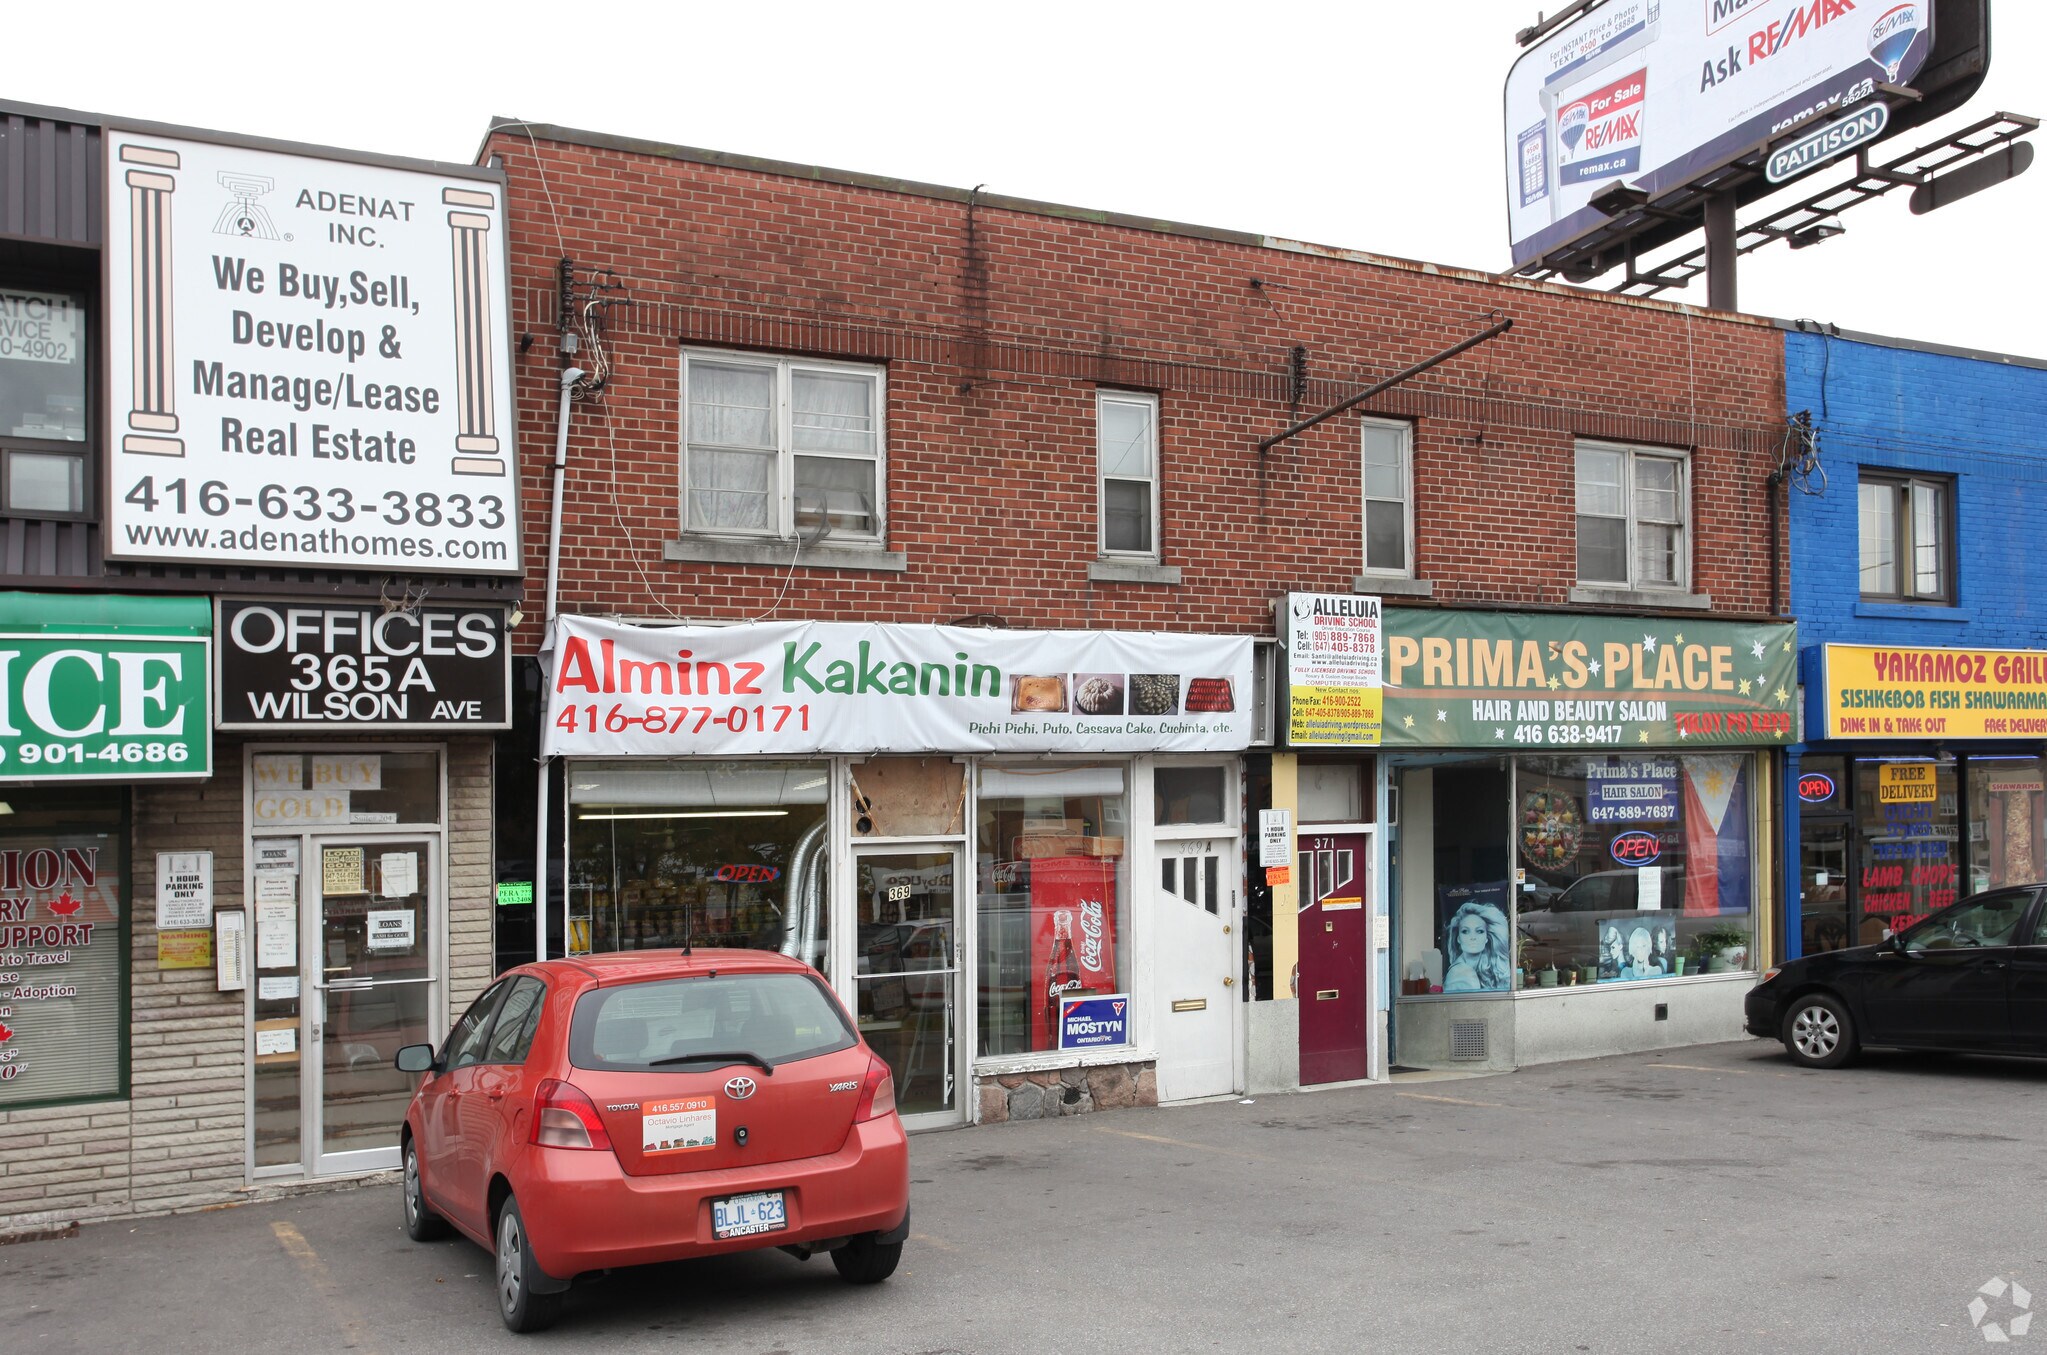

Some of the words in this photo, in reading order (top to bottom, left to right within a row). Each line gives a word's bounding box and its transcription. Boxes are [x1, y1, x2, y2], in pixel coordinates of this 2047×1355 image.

[1550, 52, 1560, 61] For
[1561, 32, 1589, 56] INSTANT
[1589, 25, 1606, 38] Price
[1607, 18, 1612, 28] &
[1614, 4, 1639, 24] Photos
[1873, 9, 1914, 40] RE/MAX
[1554, 51, 1575, 68] TEXT
[1579, 39, 1597, 55] 9500
[1601, 32, 1611, 41] to
[1614, 14, 1636, 33] 58888
[1700, 45, 1742, 94] Ask
[1590, 98, 1611, 114] For
[1614, 84, 1641, 103] Sale
[1842, 87, 1874, 107] 5622A
[1585, 110, 1641, 151] RE/MAX
[1776, 111, 1877, 175] PATTISON
[1579, 157, 1626, 176] remax.ca
[296, 188, 416, 222] ADENAT
[329, 222, 385, 248] INC.
[212, 255, 265, 293] We
[233, 310, 366, 362] Develop
[379, 325, 402, 359] &
[193, 360, 440, 414] Manage/Lease
[221, 417, 298, 457] Real
[312, 424, 416, 465] Estate
[125, 475, 505, 529] 416-633-3833
[125, 524, 507, 560] www.adenathomes.com
[1313, 598, 1378, 619] ALLELUIA
[230, 605, 497, 659] OFFICES
[1314, 616, 1346, 627] DRIVING
[1348, 618, 1378, 629] SCHOOL
[1297, 630, 1309, 640] Tel:
[1312, 631, 1330, 641] (905)
[1330, 632, 1375, 643] 889-7868
[1297, 641, 1312, 651] Cell:
[1312, 642, 1330, 652] (647)
[1331, 642, 1375, 653] 405-8378
[556, 636, 765, 695] Alminz
[783, 640, 1001, 698] Kakanin
[1389, 636, 1588, 689] PRIMA'S
[1604, 642, 1734, 691] PLACE
[1874, 652, 1986, 684] YAKAMOZ
[247, 691, 408, 721] WILSON
[430, 700, 482, 720] AVE
[1322, 696, 1361, 706] 416-900-2522
[1841, 689, 1925, 709] SISHKEBOB
[1930, 690, 1960, 709] FISH
[1965, 691, 2047, 710] SHAWARMA
[556, 703, 810, 734] 416-877-0171
[1292, 707, 1304, 717] Cell:
[1472, 701, 1512, 721] HAIR
[1516, 701, 1550, 721] AND
[1554, 701, 1614, 721] BEAUTY
[1620, 702, 1667, 721] SALON
[969, 722, 1001, 735] Pichi
[1076, 722, 1123, 735] Cassava
[1213, 723, 1234, 734] etc.
[1292, 719, 1305, 728] Web:
[1840, 717, 1865, 733] DINE
[1869, 717, 1880, 733] IN
[1884, 717, 1893, 733] &
[1896, 717, 1922, 733] TAKE
[1925, 718, 1946, 733] OUT
[1985, 718, 2007, 733] FREE
[2009, 718, 2047, 733] DELIVER
[1514, 726, 1543, 743] 416
[1547, 725, 1622, 743] 638-9417
[19, 742, 188, 763] 901-4686
[255, 762, 302, 784] WE
[314, 760, 378, 784] BUY
[1587, 762, 1638, 779] Prima's
[1642, 762, 1677, 778] Place
[1891, 767, 1926, 781] FREE
[1603, 787, 1627, 798] HAIR
[1630, 786, 1662, 798] SALON
[1799, 780, 1829, 796] OPEN
[1881, 783, 1935, 800] DELIVERY
[255, 797, 343, 820] GOLD
[1592, 806, 1675, 819] 647-889-7637
[1179, 840, 1202, 854] 369
[1205, 840, 1212, 852] A
[1314, 838, 1335, 849] 371
[1613, 838, 1659, 857] OPEN
[717, 864, 779, 882] OPEN
[1862, 865, 1904, 888] LAMB
[1911, 863, 1958, 886] CHOPS
[174, 890, 195, 898] ONLY
[889, 885, 910, 900] 369
[1864, 891, 1911, 913] CHICKEN
[1929, 889, 1955, 908] BEEF
[161, 932, 208, 940] WARNING
[1081, 898, 1103, 972] Coca-Cola
[8, 954, 22, 965] to
[26, 950, 70, 965] Travel
[13, 985, 76, 999] Adoption
[1067, 1020, 1122, 1035] MOSTYN
[828, 1081, 858, 1092] YARIS
[606, 1103, 640, 1111] TOYOTA
[652, 1100, 707, 1113] 416.557.0910
[647, 1115, 677, 1126] Octavio
[679, 1113, 712, 1123] Linhares
[715, 1205, 750, 1228] BLJL
[758, 1199, 784, 1221] 623
[729, 1223, 769, 1237] ANCASTER
